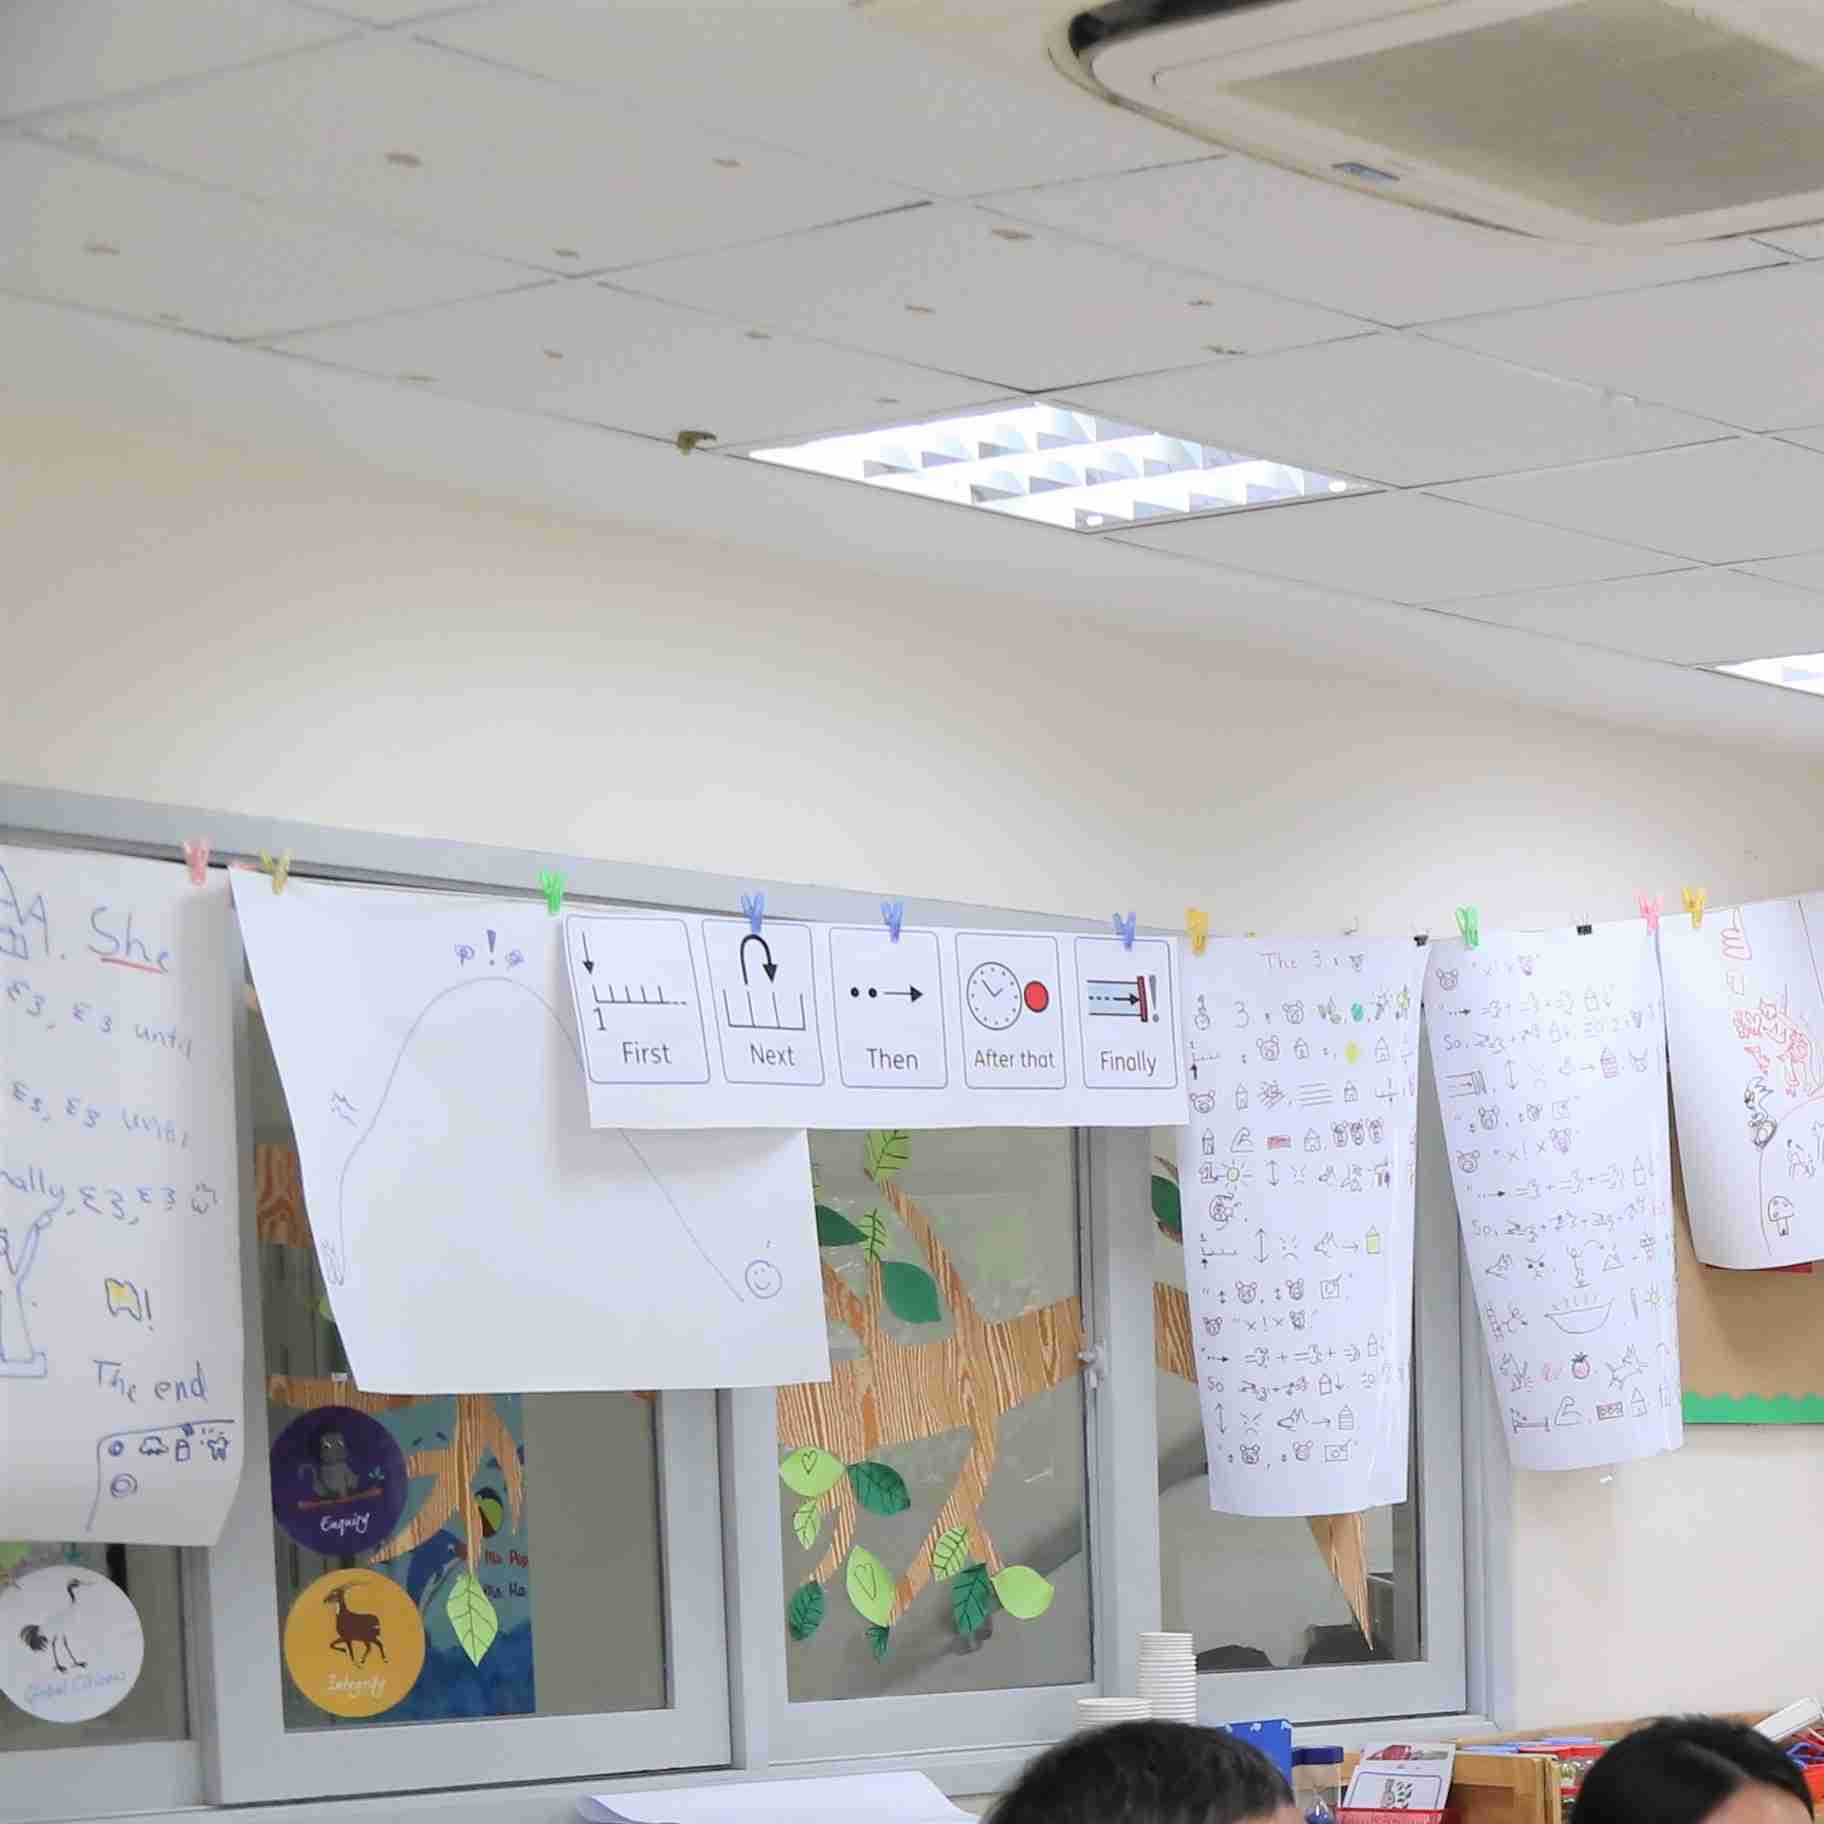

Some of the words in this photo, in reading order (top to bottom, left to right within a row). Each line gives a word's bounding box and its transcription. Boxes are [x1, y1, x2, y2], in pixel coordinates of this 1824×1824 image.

[87, 905, 169, 975] She
[621, 1041, 671, 1065] First
[749, 1042, 795, 1067] Next
[866, 1048, 919, 1072] Then
[974, 1048, 1014, 1070] After
[1018, 1048, 1056, 1070] that
[1099, 1050, 1158, 1075] Finally
[93, 1360, 136, 1402] The
[154, 1361, 208, 1401] end
